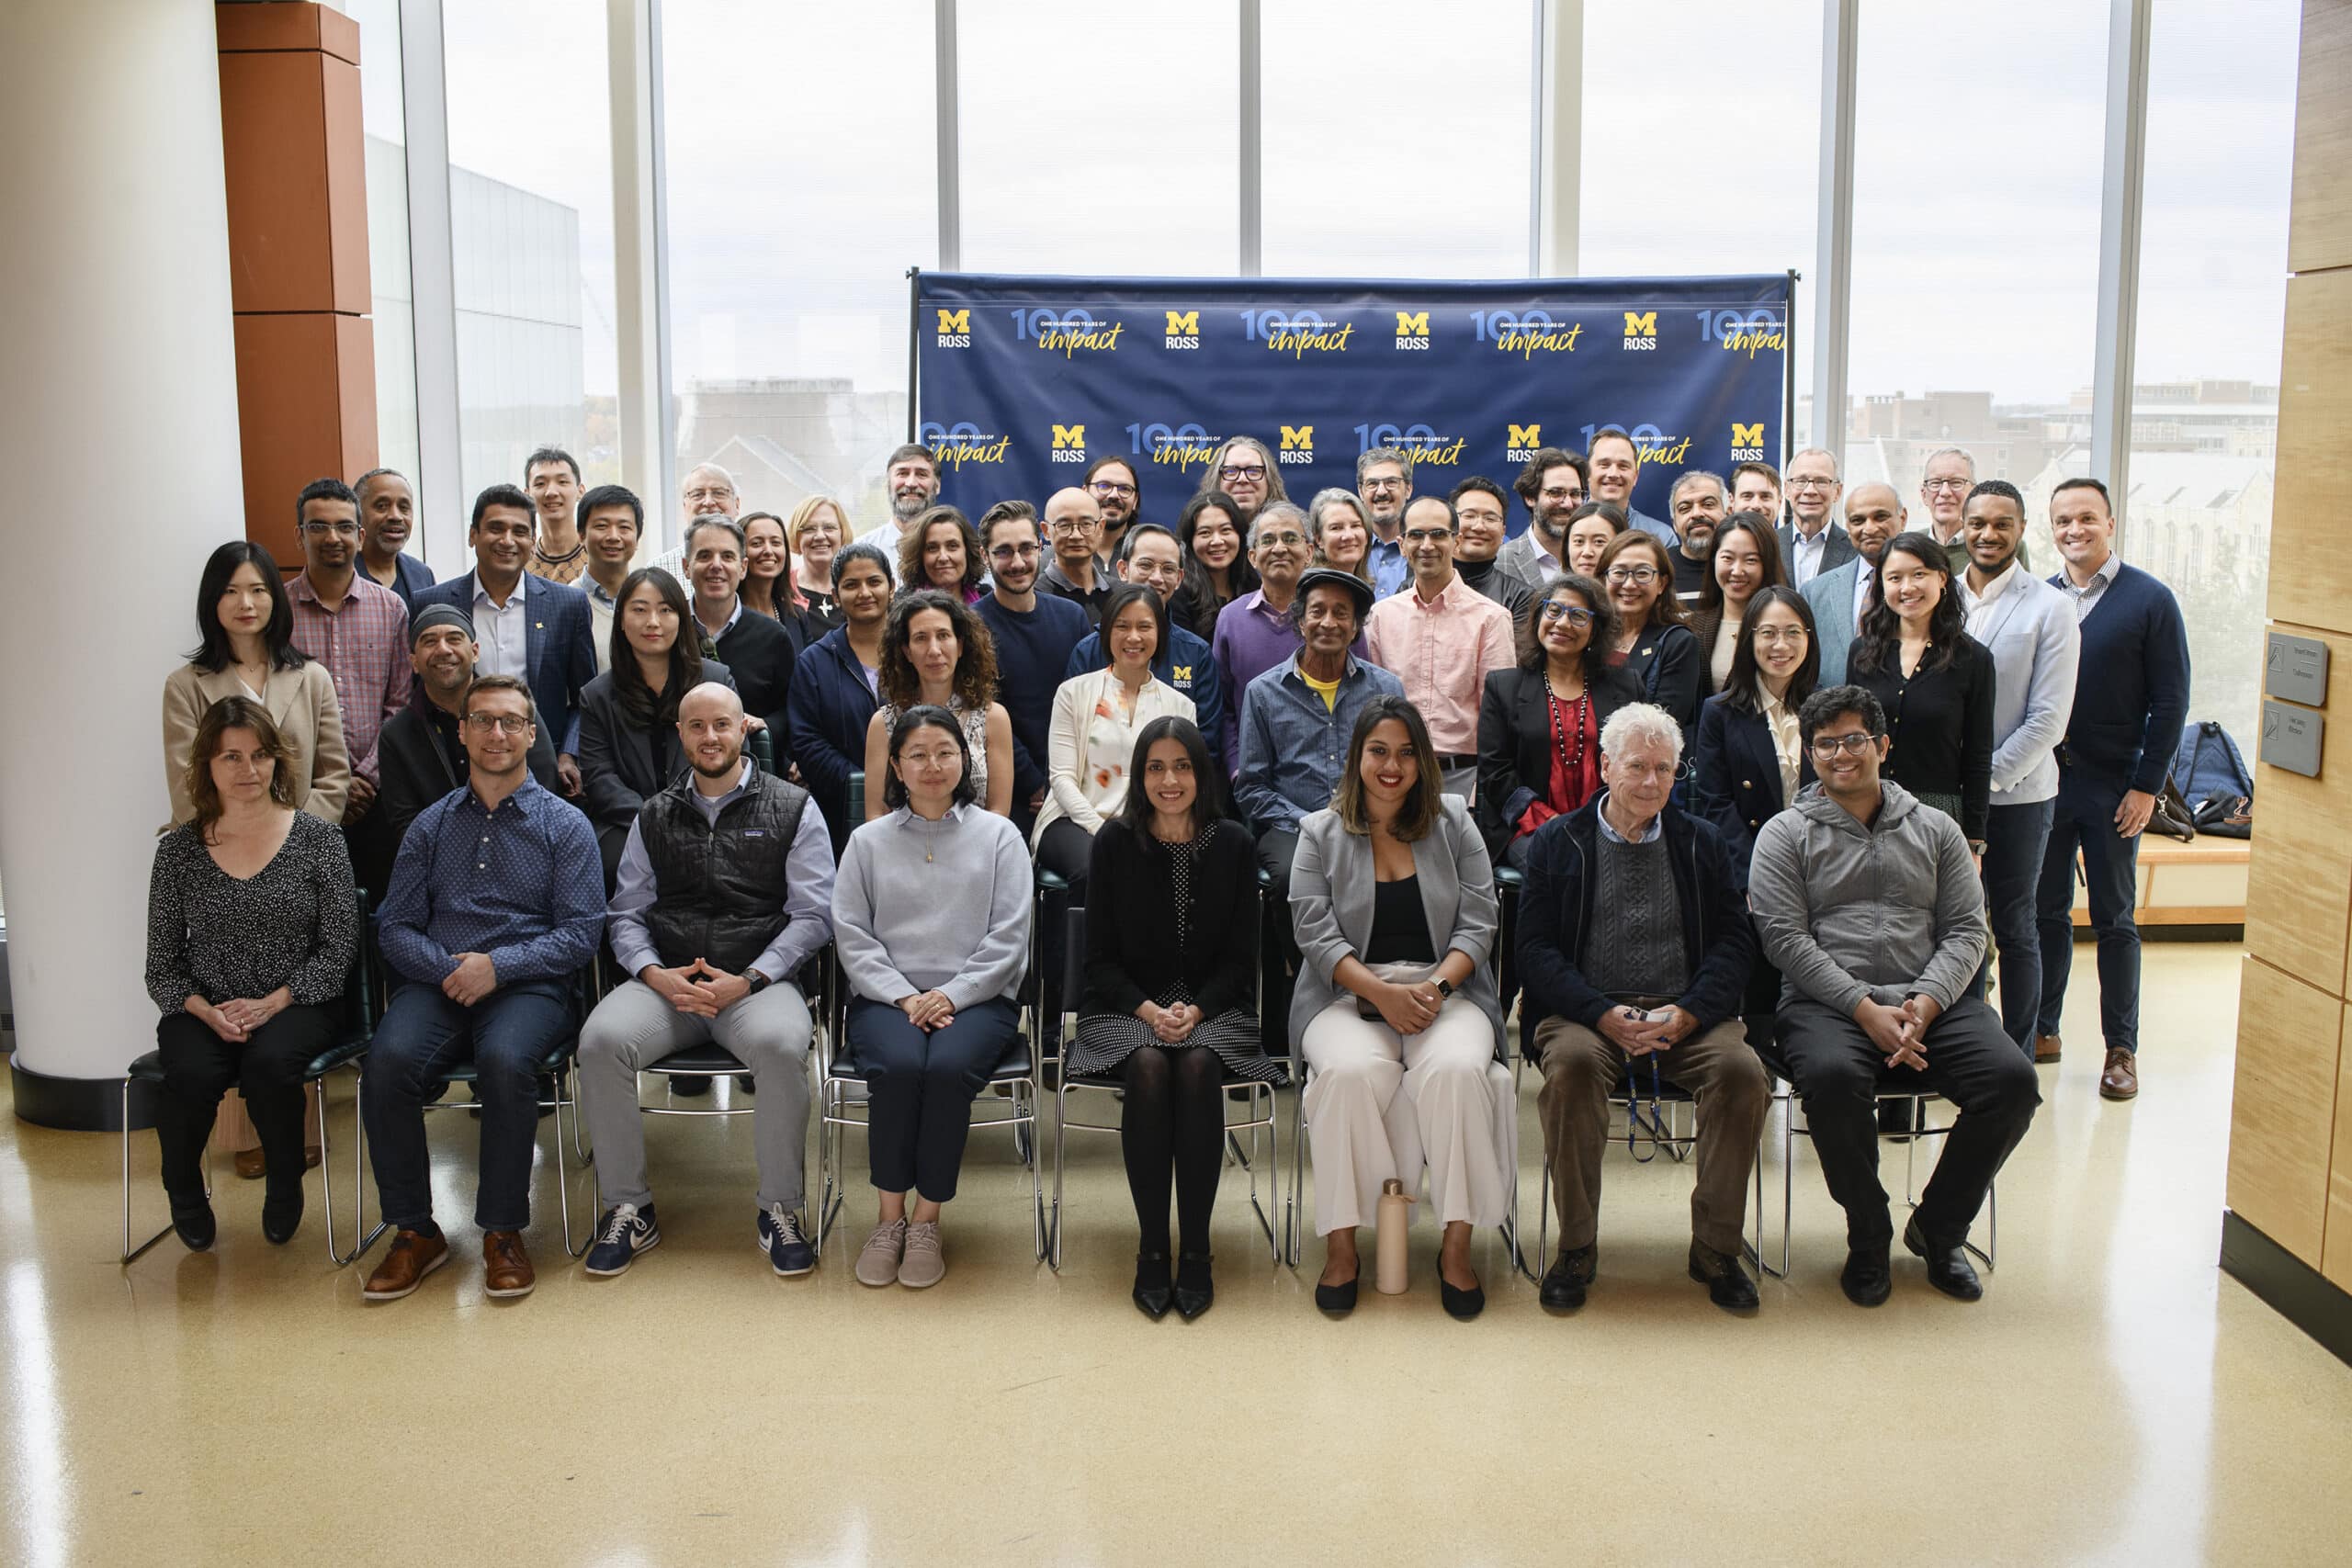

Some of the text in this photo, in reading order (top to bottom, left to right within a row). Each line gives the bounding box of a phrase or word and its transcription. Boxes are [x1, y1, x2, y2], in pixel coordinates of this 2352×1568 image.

[938, 309, 970, 333] M
[1011, 308, 1093, 340] 100
[1166, 311, 1199, 335] M
[1240, 309, 1322, 340] 100
[1396, 312, 1429, 335] M
[1470, 310, 1552, 341] 100
[1624, 312, 1657, 336] M
[1697, 309, 1777, 341] 100
[938, 335, 970, 348] ROSS
[1039, 322, 1125, 359] impact
[1166, 336, 1199, 349] ROSS
[1269, 323, 1355, 359] impact
[1396, 337, 1429, 350] ROSS
[1498, 323, 1584, 360] impact
[1624, 338, 1656, 350] ROSS
[1724, 330, 1786, 359] impa
[920, 422, 980, 452] 00
[1052, 425, 1085, 448] M
[1125, 423, 1207, 454] 100
[1280, 426, 1313, 449] M
[1508, 424, 1540, 448] M
[1580, 423, 1661, 455] 10
[1732, 423, 1764, 447] M
[1052, 450, 1085, 463] ROSS
[1153, 444, 1221, 474] impa
[1280, 451, 1313, 463] ROSS
[1637, 437, 1692, 470] pact
[1731, 449, 1764, 461] ROSS
[1173, 666, 1192, 680] M
